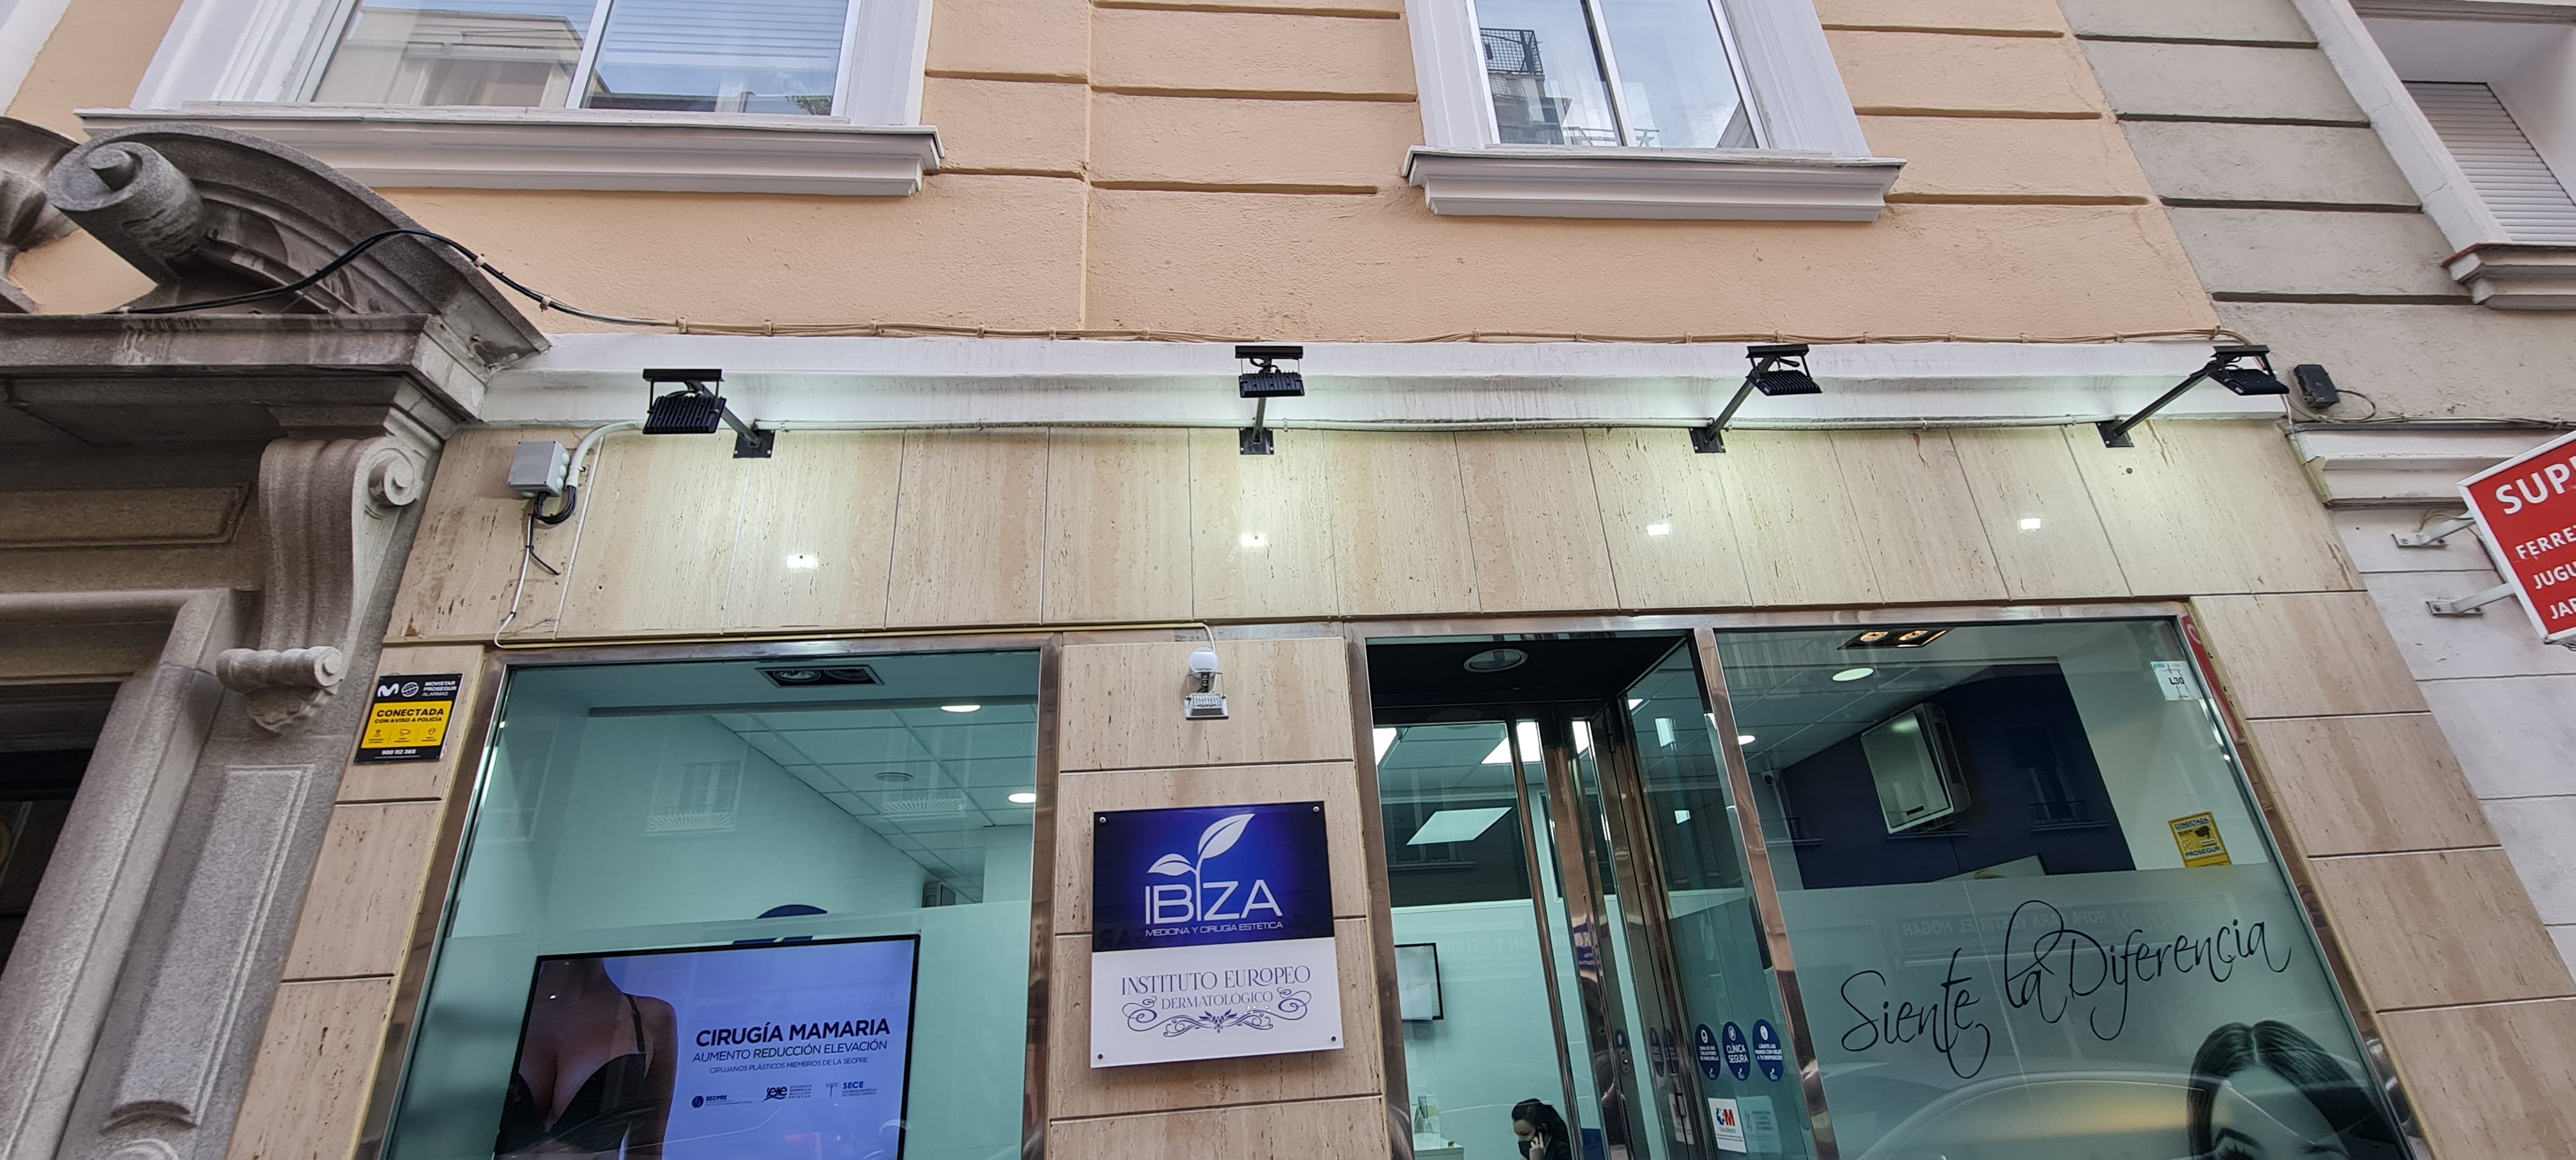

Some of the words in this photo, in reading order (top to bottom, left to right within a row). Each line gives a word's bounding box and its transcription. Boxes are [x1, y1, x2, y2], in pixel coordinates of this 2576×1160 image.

[2496, 455, 2576, 515] SUP
[2515, 524, 2576, 560] FERRE
[376, 708, 444, 717] CONECTADA
[2174, 817, 2210, 829] CONECTADA
[2185, 846, 2221, 857] PROSEGUR
[1145, 856, 1284, 925] IBIZA
[1146, 927, 1190, 936] MEDICINA
[1200, 924, 1238, 933] CIRUGÍA
[1239, 921, 1284, 931] ESTÉTICA
[1121, 972, 1217, 995] INSTITUTO
[1223, 965, 1310, 989] EUROPEO
[1162, 991, 1273, 1009] DERMATOLÓGICO
[1841, 947, 1990, 1079] Siente
[2034, 919, 2291, 1041] Diferencia
[695, 1021, 783, 1046] CIRUGÍA
[789, 1018, 890, 1041] MAMARIA
[692, 1049, 751, 1062] AUMENTO
[753, 1043, 821, 1058] REDUCCIÓN
[824, 1039, 887, 1054] ELEVACIÓN
[1726, 1043, 1746, 1053] CLÍNICA
[709, 1065, 748, 1074] CIRUJANOS
[749, 1061, 786, 1071] PLÁSTICOS
[786, 1059, 822, 1068] MIEMBROS
[843, 1057, 868, 1065] SECPRE
[1728, 1053, 1749, 1064] SEGURA
